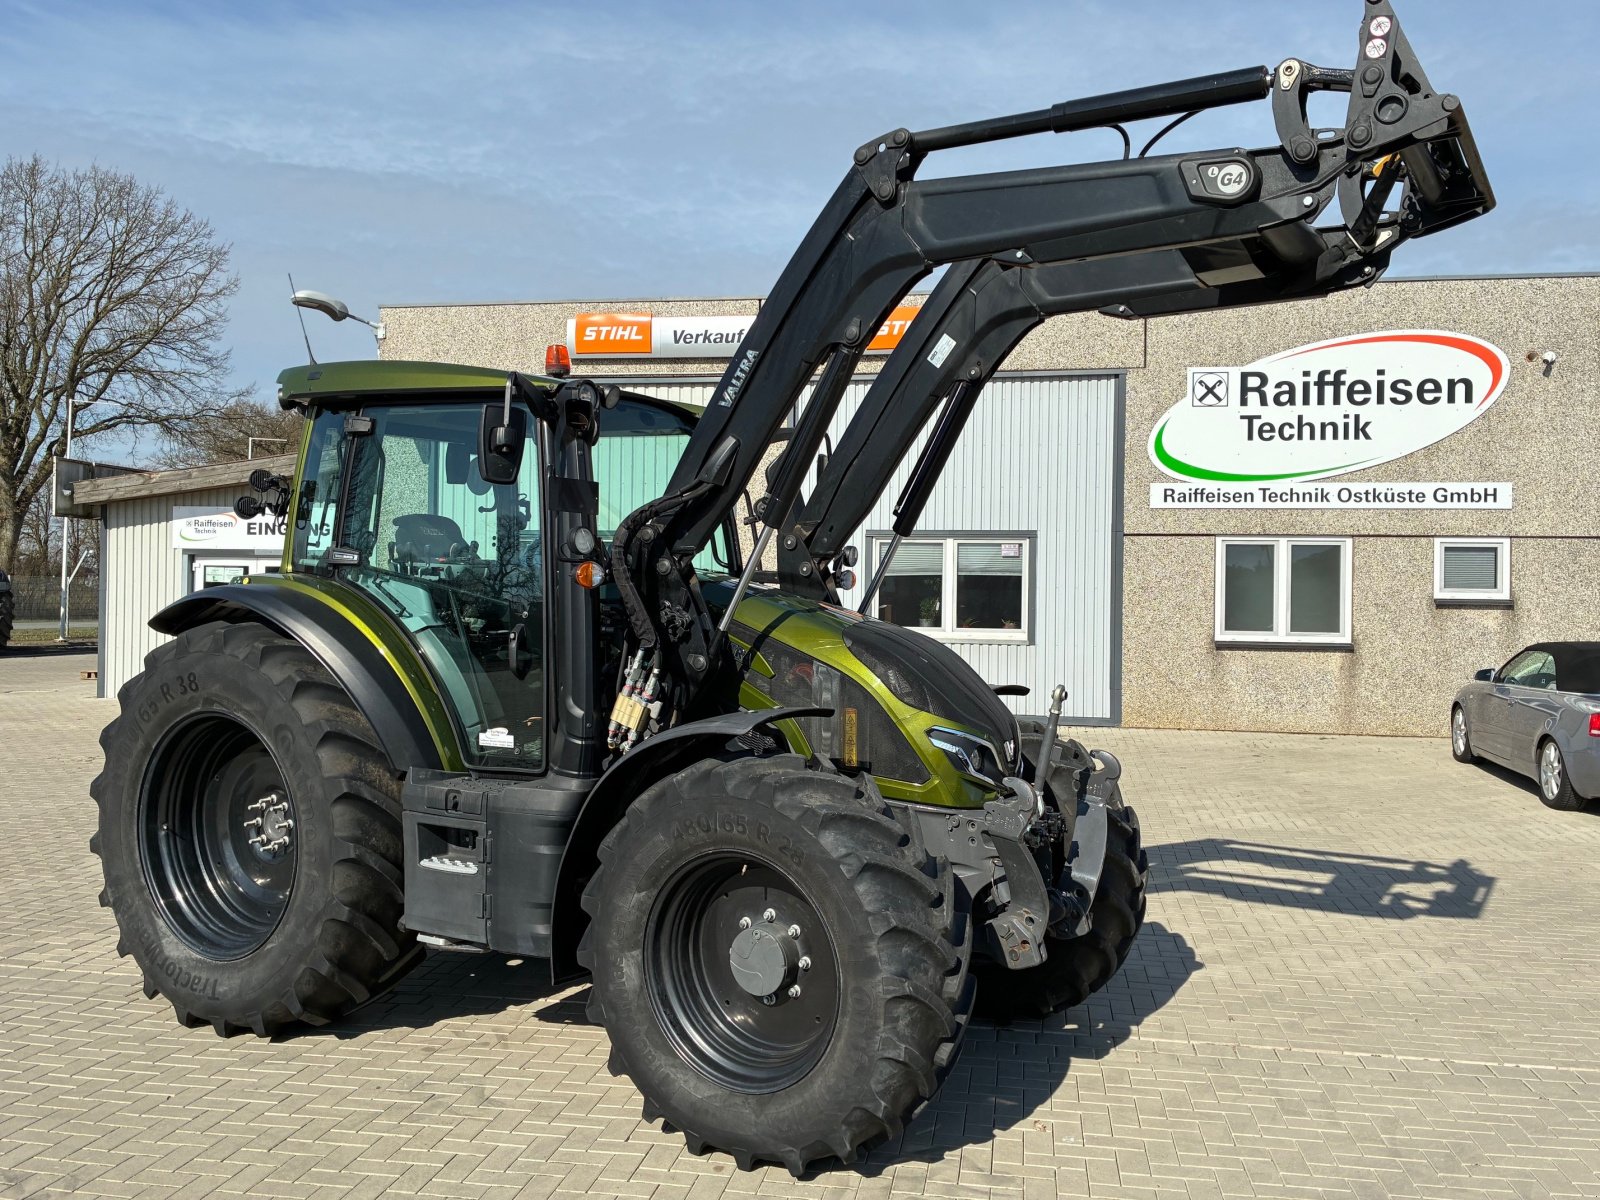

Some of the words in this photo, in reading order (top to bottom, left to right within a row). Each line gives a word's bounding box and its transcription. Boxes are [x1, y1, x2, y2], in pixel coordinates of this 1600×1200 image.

[1210, 167, 1216, 176] L
[1220, 172, 1244, 187] G4
[583, 325, 643, 341] STIHL
[673, 329, 745, 345] Verkauf
[717, 349, 760, 408] VALTRA
[1239, 369, 1474, 407] Raiffeisen
[1239, 414, 1372, 442] Technik
[1163, 487, 1255, 503] Raiffeisen
[1258, 487, 1331, 503] Technik
[1337, 487, 1427, 503] Ostküste
[1432, 487, 1498, 503] GmbH
[193, 519, 234, 528] Raiffeisen
[194, 527, 217, 535] Technik
[160, 682, 175, 704] R
[175, 671, 200, 696] 38
[672, 811, 748, 841] 480/65
[755, 820, 771, 845] R
[779, 834, 806, 865] 28
